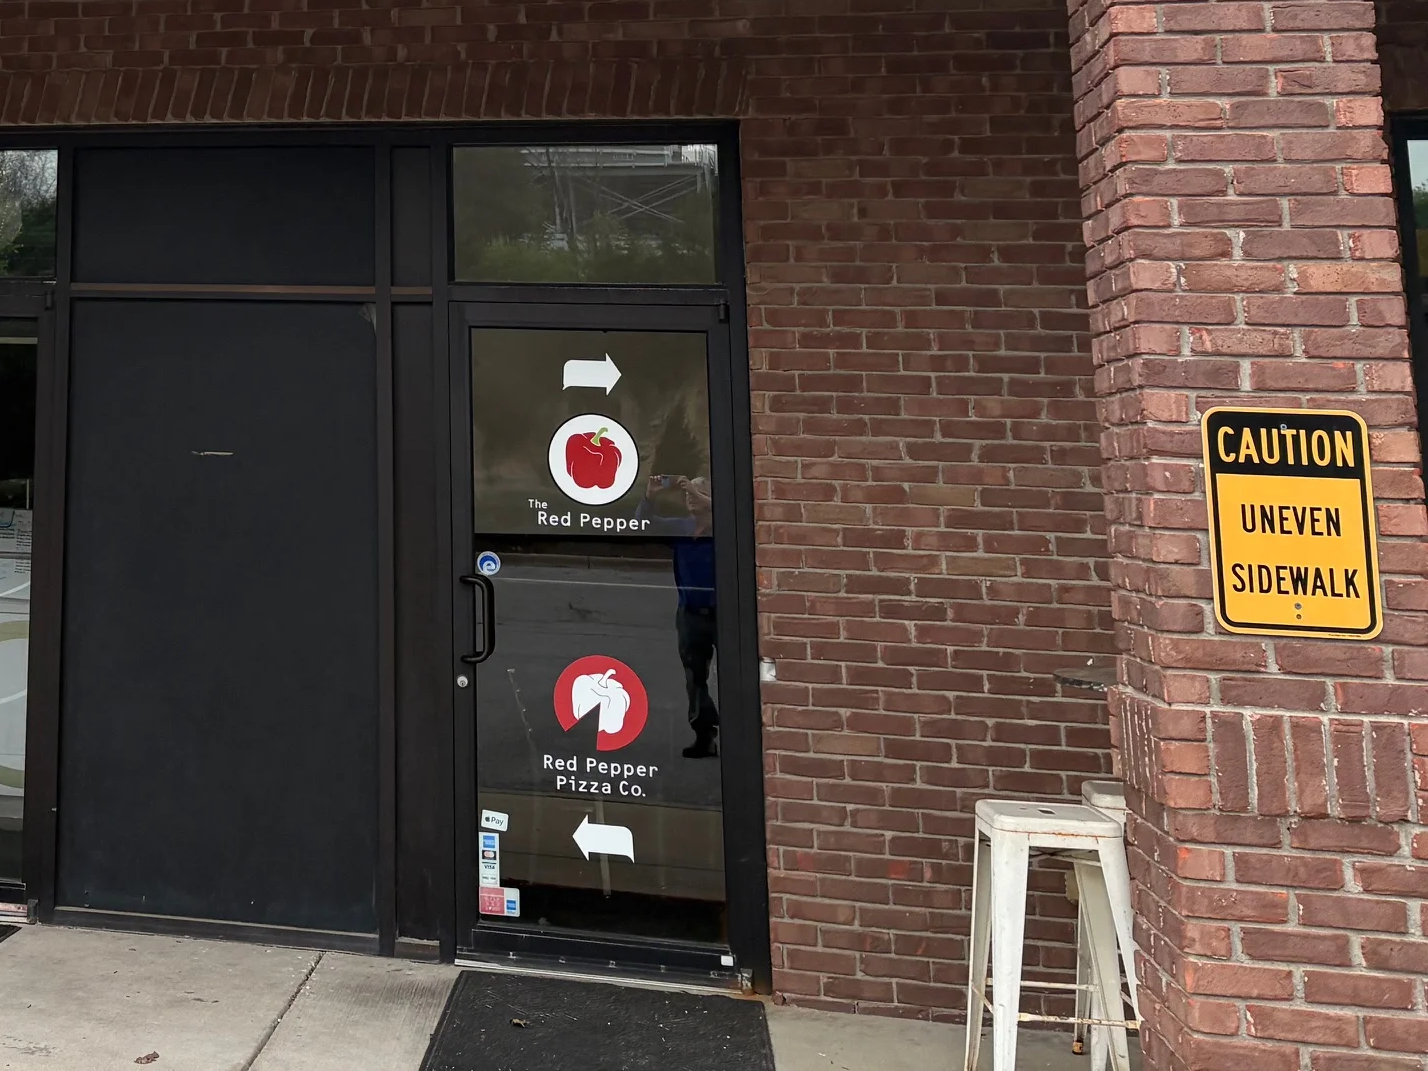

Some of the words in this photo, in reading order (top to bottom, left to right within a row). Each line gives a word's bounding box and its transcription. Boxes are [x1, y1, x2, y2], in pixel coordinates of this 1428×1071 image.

[1217, 425, 1356, 468] CAUTION
[528, 498, 548, 509] The
[537, 511, 571, 527] Red
[580, 513, 651, 533] Pepper
[1240, 503, 1342, 537] UNEVEN
[1231, 562, 1361, 599] SIDEWALK
[543, 754, 578, 772] Red
[586, 757, 659, 779] Pepper
[556, 775, 612, 795] Pizza
[619, 780, 647, 798] Co.
[491, 816, 504, 827] Pay
